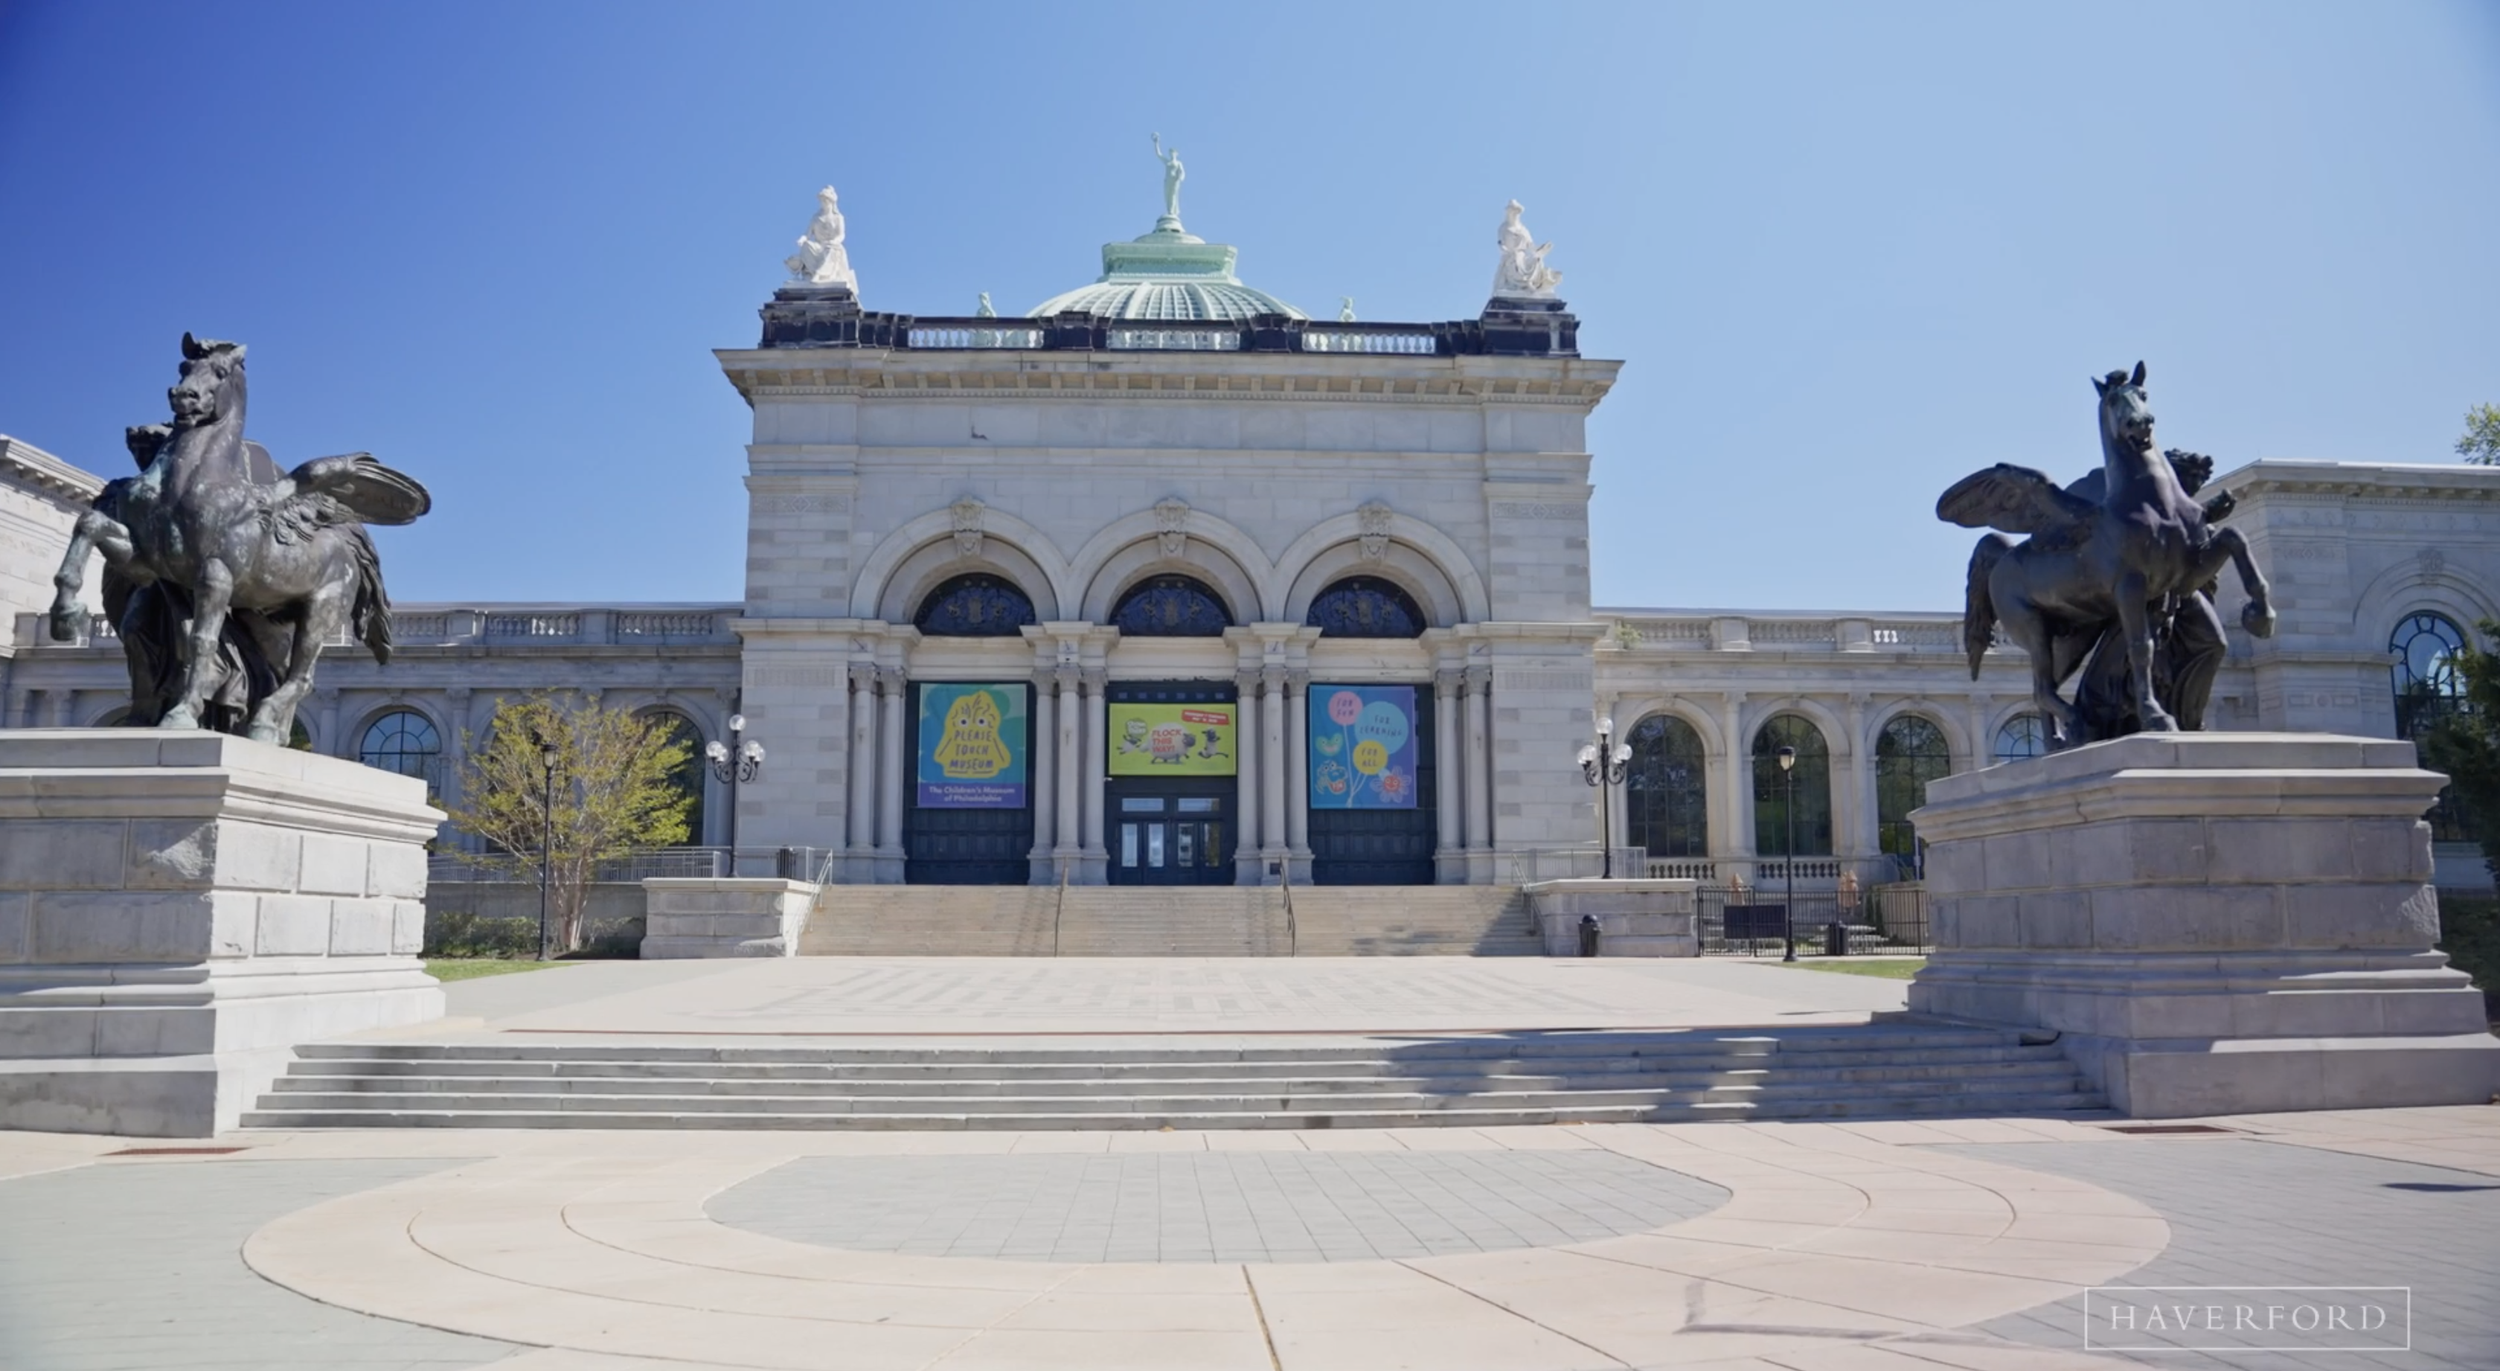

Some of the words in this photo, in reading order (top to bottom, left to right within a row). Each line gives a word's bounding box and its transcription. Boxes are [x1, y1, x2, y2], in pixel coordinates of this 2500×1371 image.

[1336, 698, 1353, 707] FOR
[1375, 714, 1390, 724] FOR
[954, 730, 992, 742] PLEASE
[955, 744, 989, 756] TOUCH
[1361, 747, 1378, 756] FOR
[949, 758, 994, 770] MUSEUM
[944, 786, 982, 794] Children's
[944, 794, 952, 802] of
[953, 794, 1002, 803] Philadelphia
